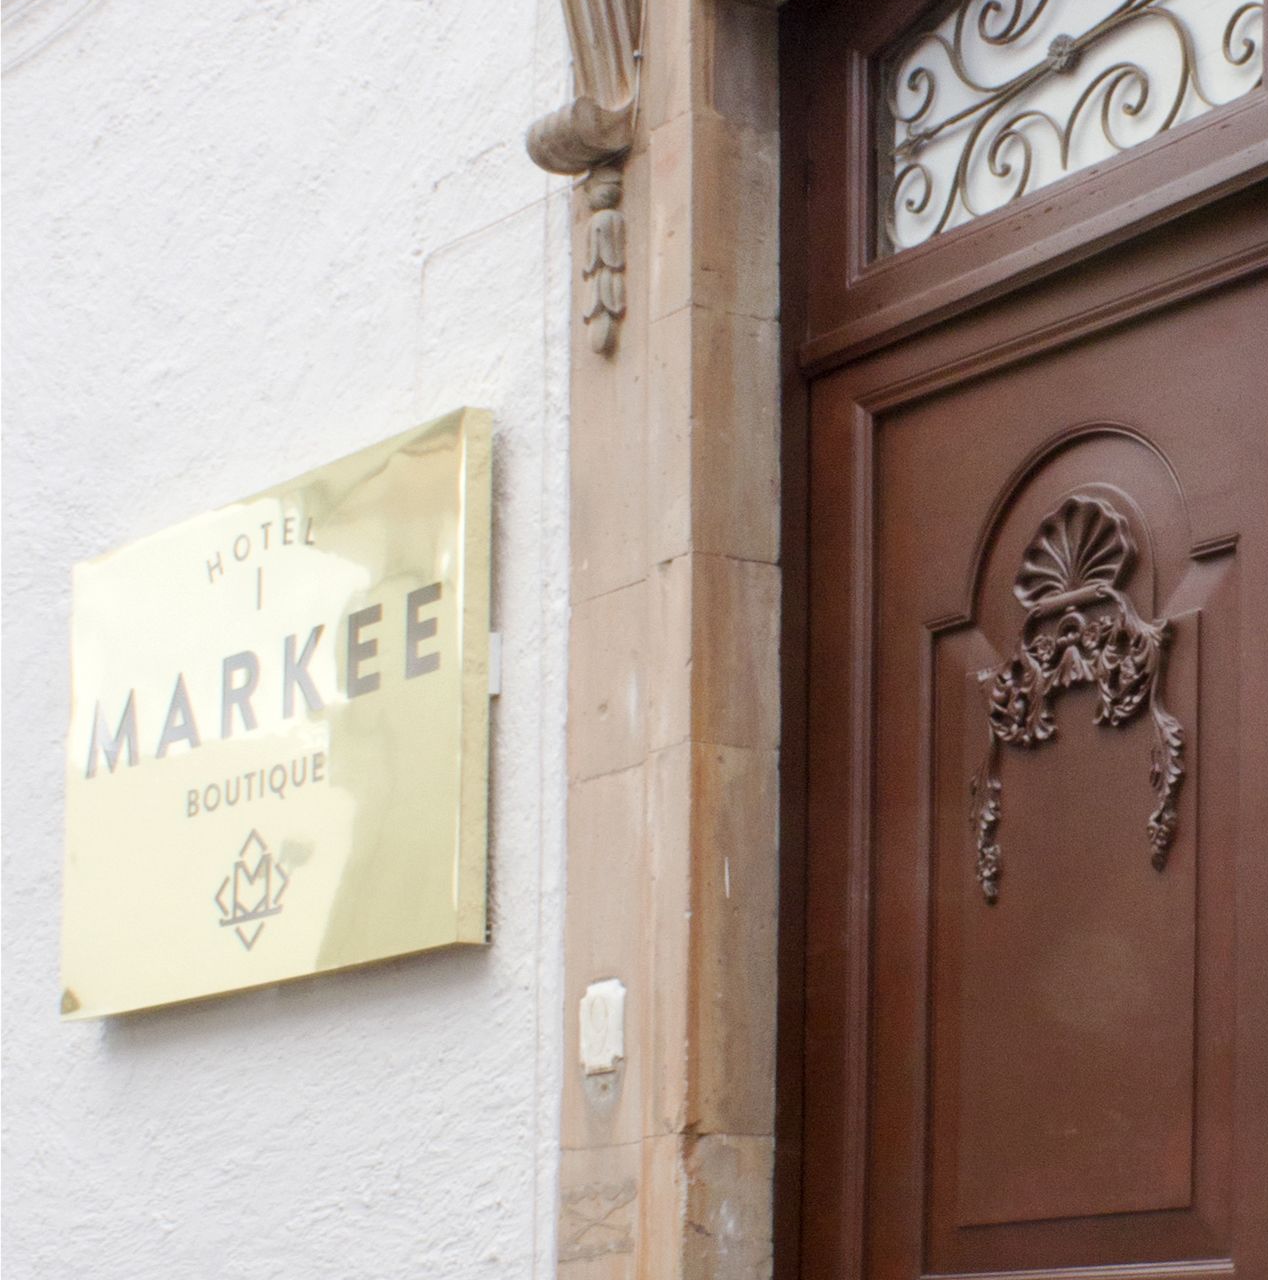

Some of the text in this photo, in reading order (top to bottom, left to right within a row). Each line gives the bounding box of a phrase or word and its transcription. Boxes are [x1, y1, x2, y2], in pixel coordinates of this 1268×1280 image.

[205, 517, 316, 583] HOTEL
[86, 582, 442, 779] MARKEE
[186, 751, 325, 818] BOUTIQUE
